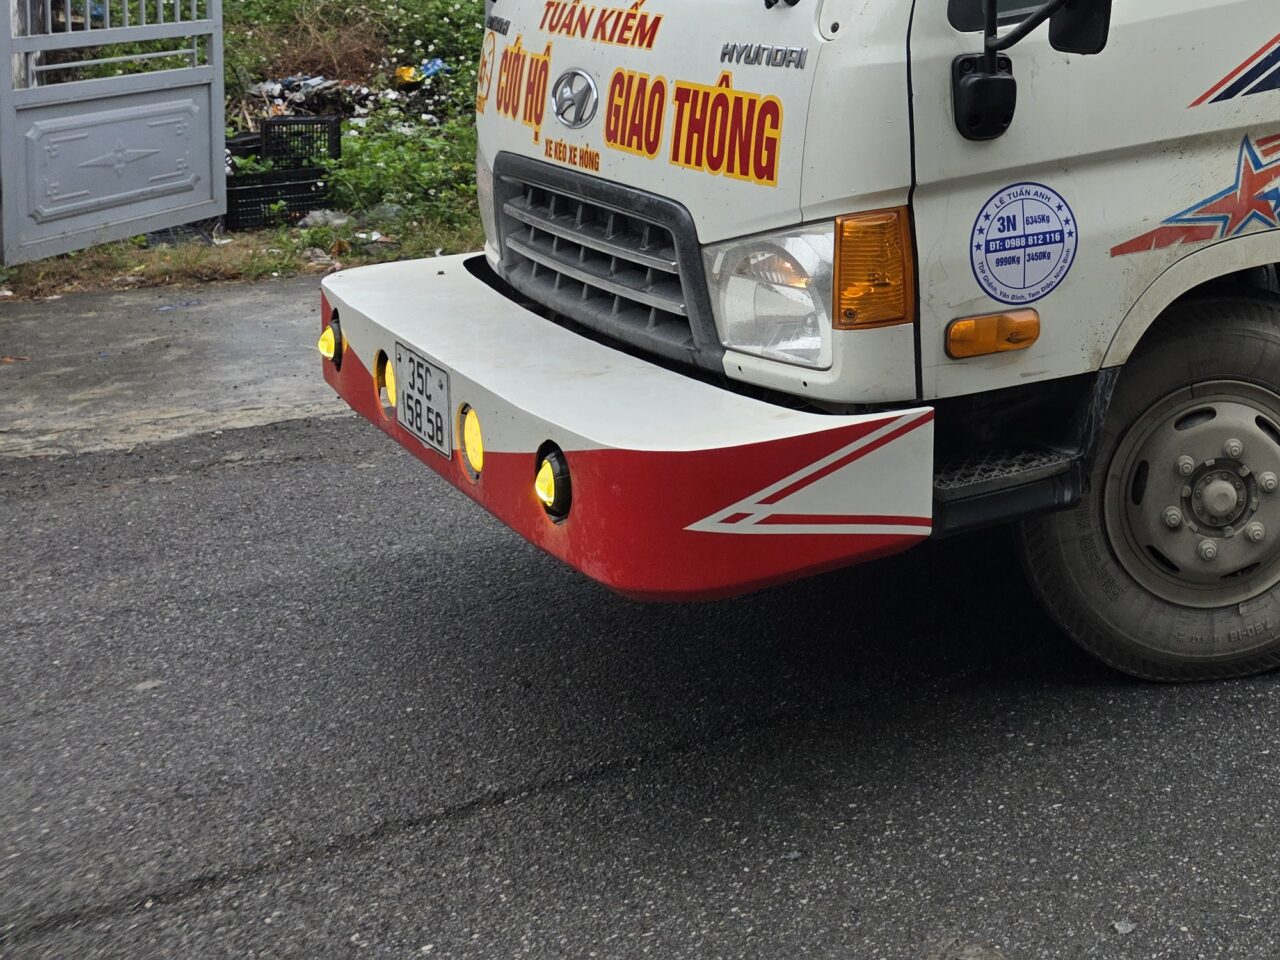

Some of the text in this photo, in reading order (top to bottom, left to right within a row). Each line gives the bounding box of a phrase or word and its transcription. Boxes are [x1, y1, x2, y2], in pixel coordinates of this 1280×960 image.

[720, 42, 808, 69] HYUNDAI
[496, 34, 528, 120] CỨU
[523, 41, 552, 144] HỘ
[604, 67, 667, 159] GIAO
[670, 71, 783, 187] THÔNG
[544, 138, 553, 158] XE
[554, 138, 567, 162] KÉO
[568, 145, 578, 165] XE
[995, 187, 1051, 209] LÊ TUẤN ANH
[997, 214, 1016, 233] 3N
[1025, 214, 1050, 225] 6345Kg
[990, 232, 1060, 251] ĐT: 0988 812 116
[995, 256, 1021, 267] 9990Kg
[1026, 251, 1051, 262] 3450Kg
[408, 357, 432, 402] 35C
[402, 390, 444, 446] 158.58
